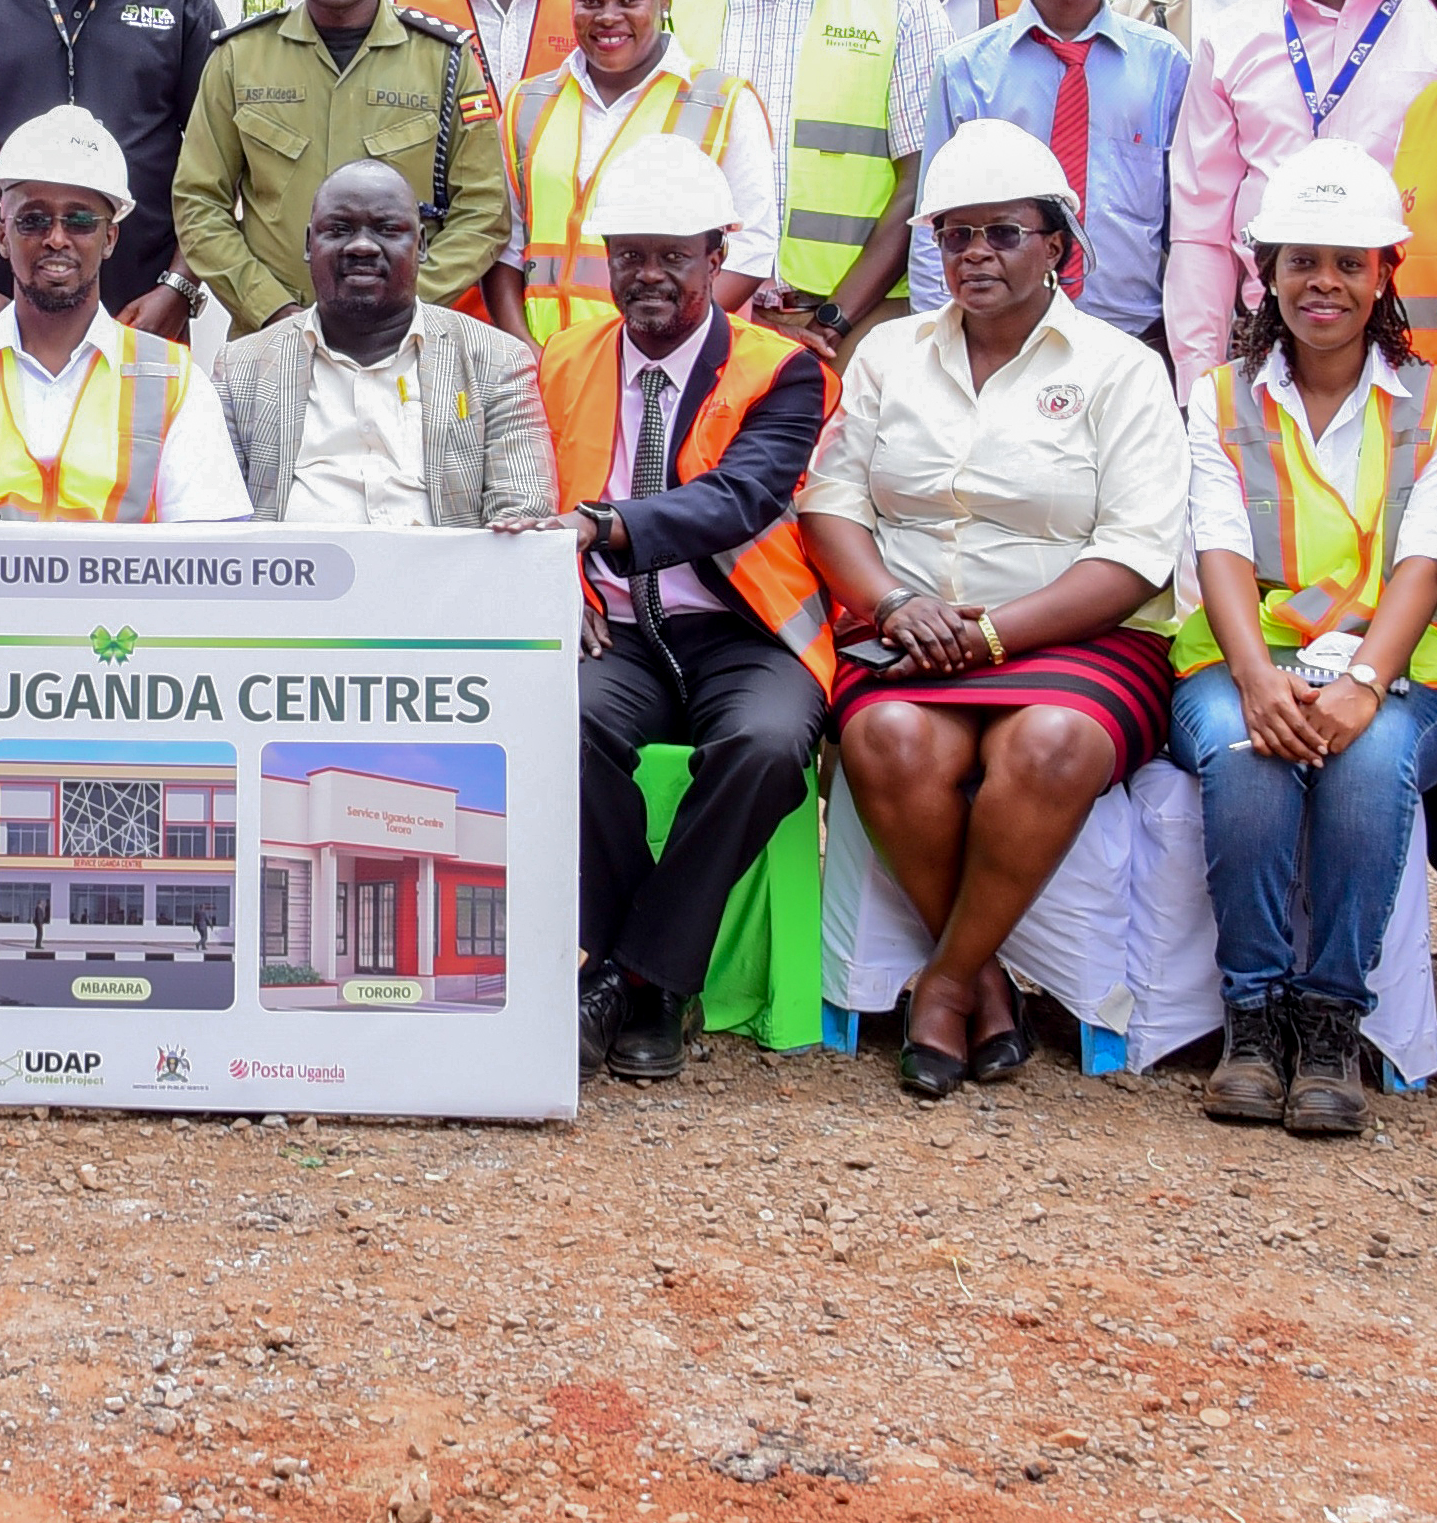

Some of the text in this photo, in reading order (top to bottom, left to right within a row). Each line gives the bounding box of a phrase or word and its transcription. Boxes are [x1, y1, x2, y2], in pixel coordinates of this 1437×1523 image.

[140, 6, 175, 19] NITA
[825, 24, 882, 44] PRISMA
[376, 89, 429, 109] POLICE
[78, 556, 243, 587] BREAKING
[252, 558, 316, 587] FOR
[238, 674, 492, 724] CENTRES
[346, 806, 444, 830] Service Uganda Centre
[80, 982, 143, 994] MBARARA
[356, 986, 411, 998] TORORO
[25, 1051, 102, 1074] UDAP
[251, 1061, 345, 1082] Posta Uganda
[25, 1075, 104, 1087] GovNet Project
